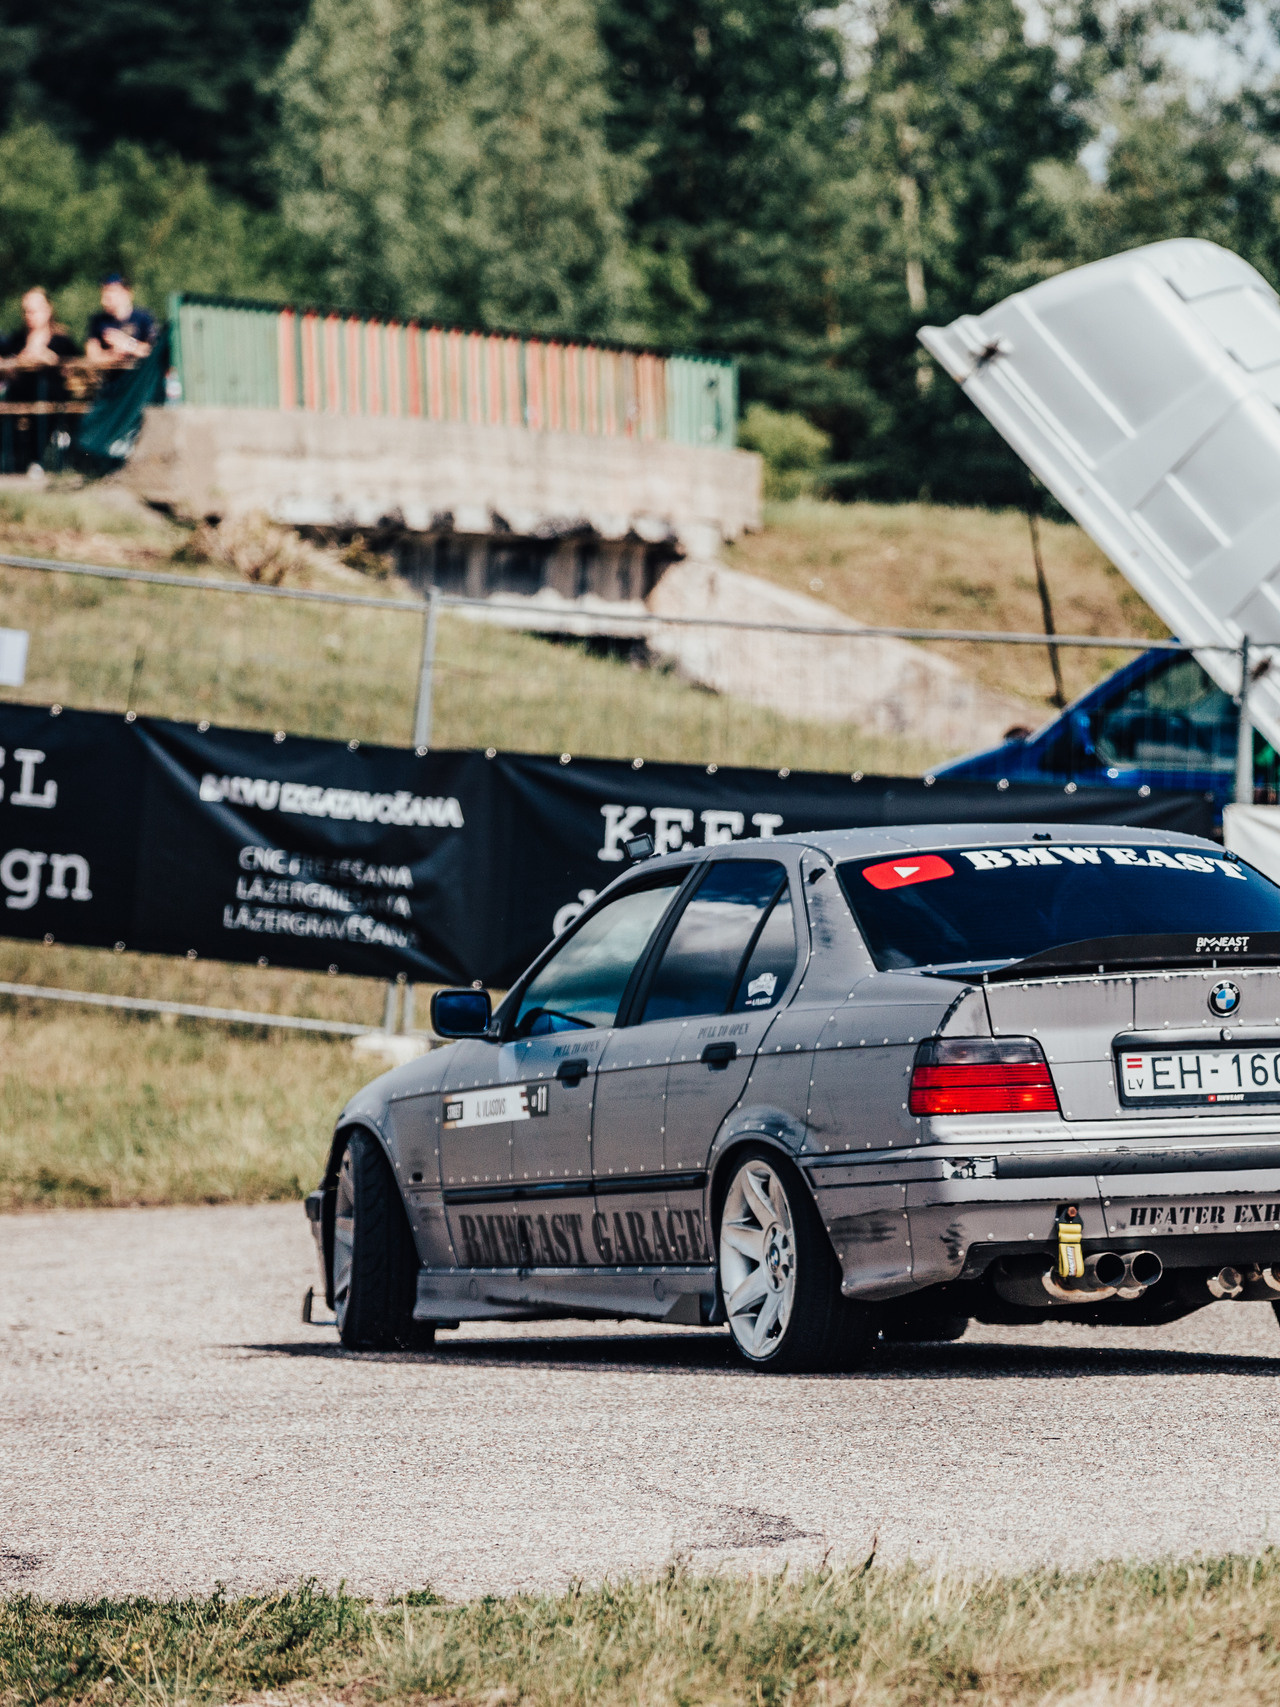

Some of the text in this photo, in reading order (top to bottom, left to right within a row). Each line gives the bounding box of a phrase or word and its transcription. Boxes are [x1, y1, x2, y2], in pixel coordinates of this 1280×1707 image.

[0, 748, 58, 809] L
[238, 846, 290, 874] CNC
[960, 847, 1248, 881] BMWEAST
[1128, 1079, 1144, 1090] LV
[1130, 1206, 1225, 1226] HEATER
[459, 1208, 710, 1264] BMWEAST GARAGE
